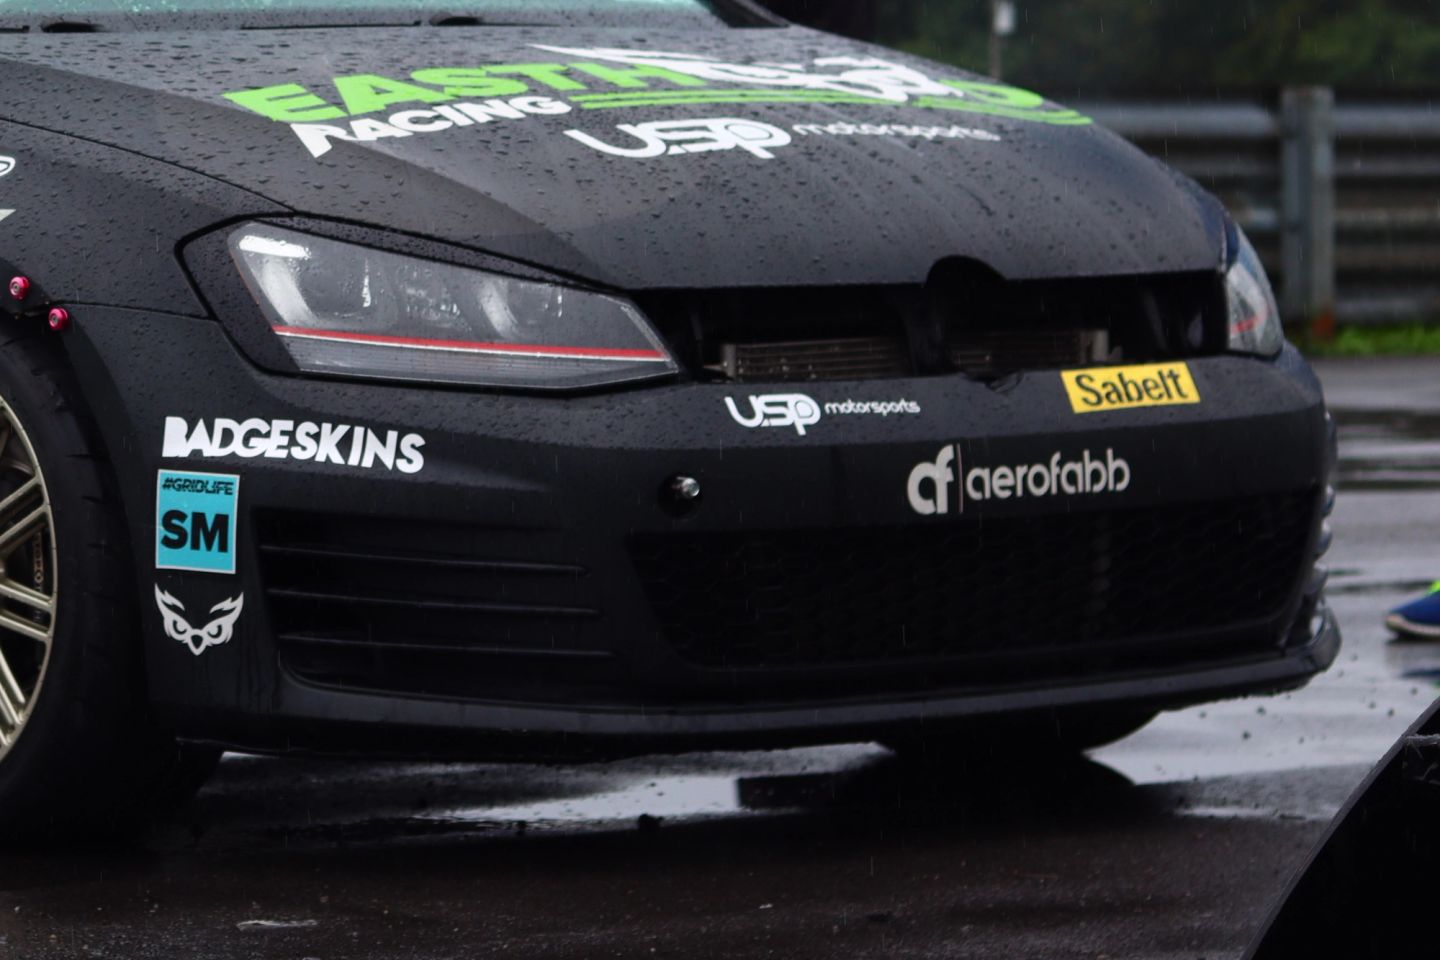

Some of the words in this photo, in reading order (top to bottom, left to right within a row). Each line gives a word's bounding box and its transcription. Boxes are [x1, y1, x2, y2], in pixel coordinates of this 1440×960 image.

[290, 96, 572, 158] RACING
[792, 123, 1001, 141] motorsports
[825, 397, 920, 417] motorsports
[1074, 367, 1189, 407] Sabelt
[162, 416, 426, 474] BADGESKINS
[966, 448, 1131, 501] aerofabb
[160, 509, 229, 553] SM
